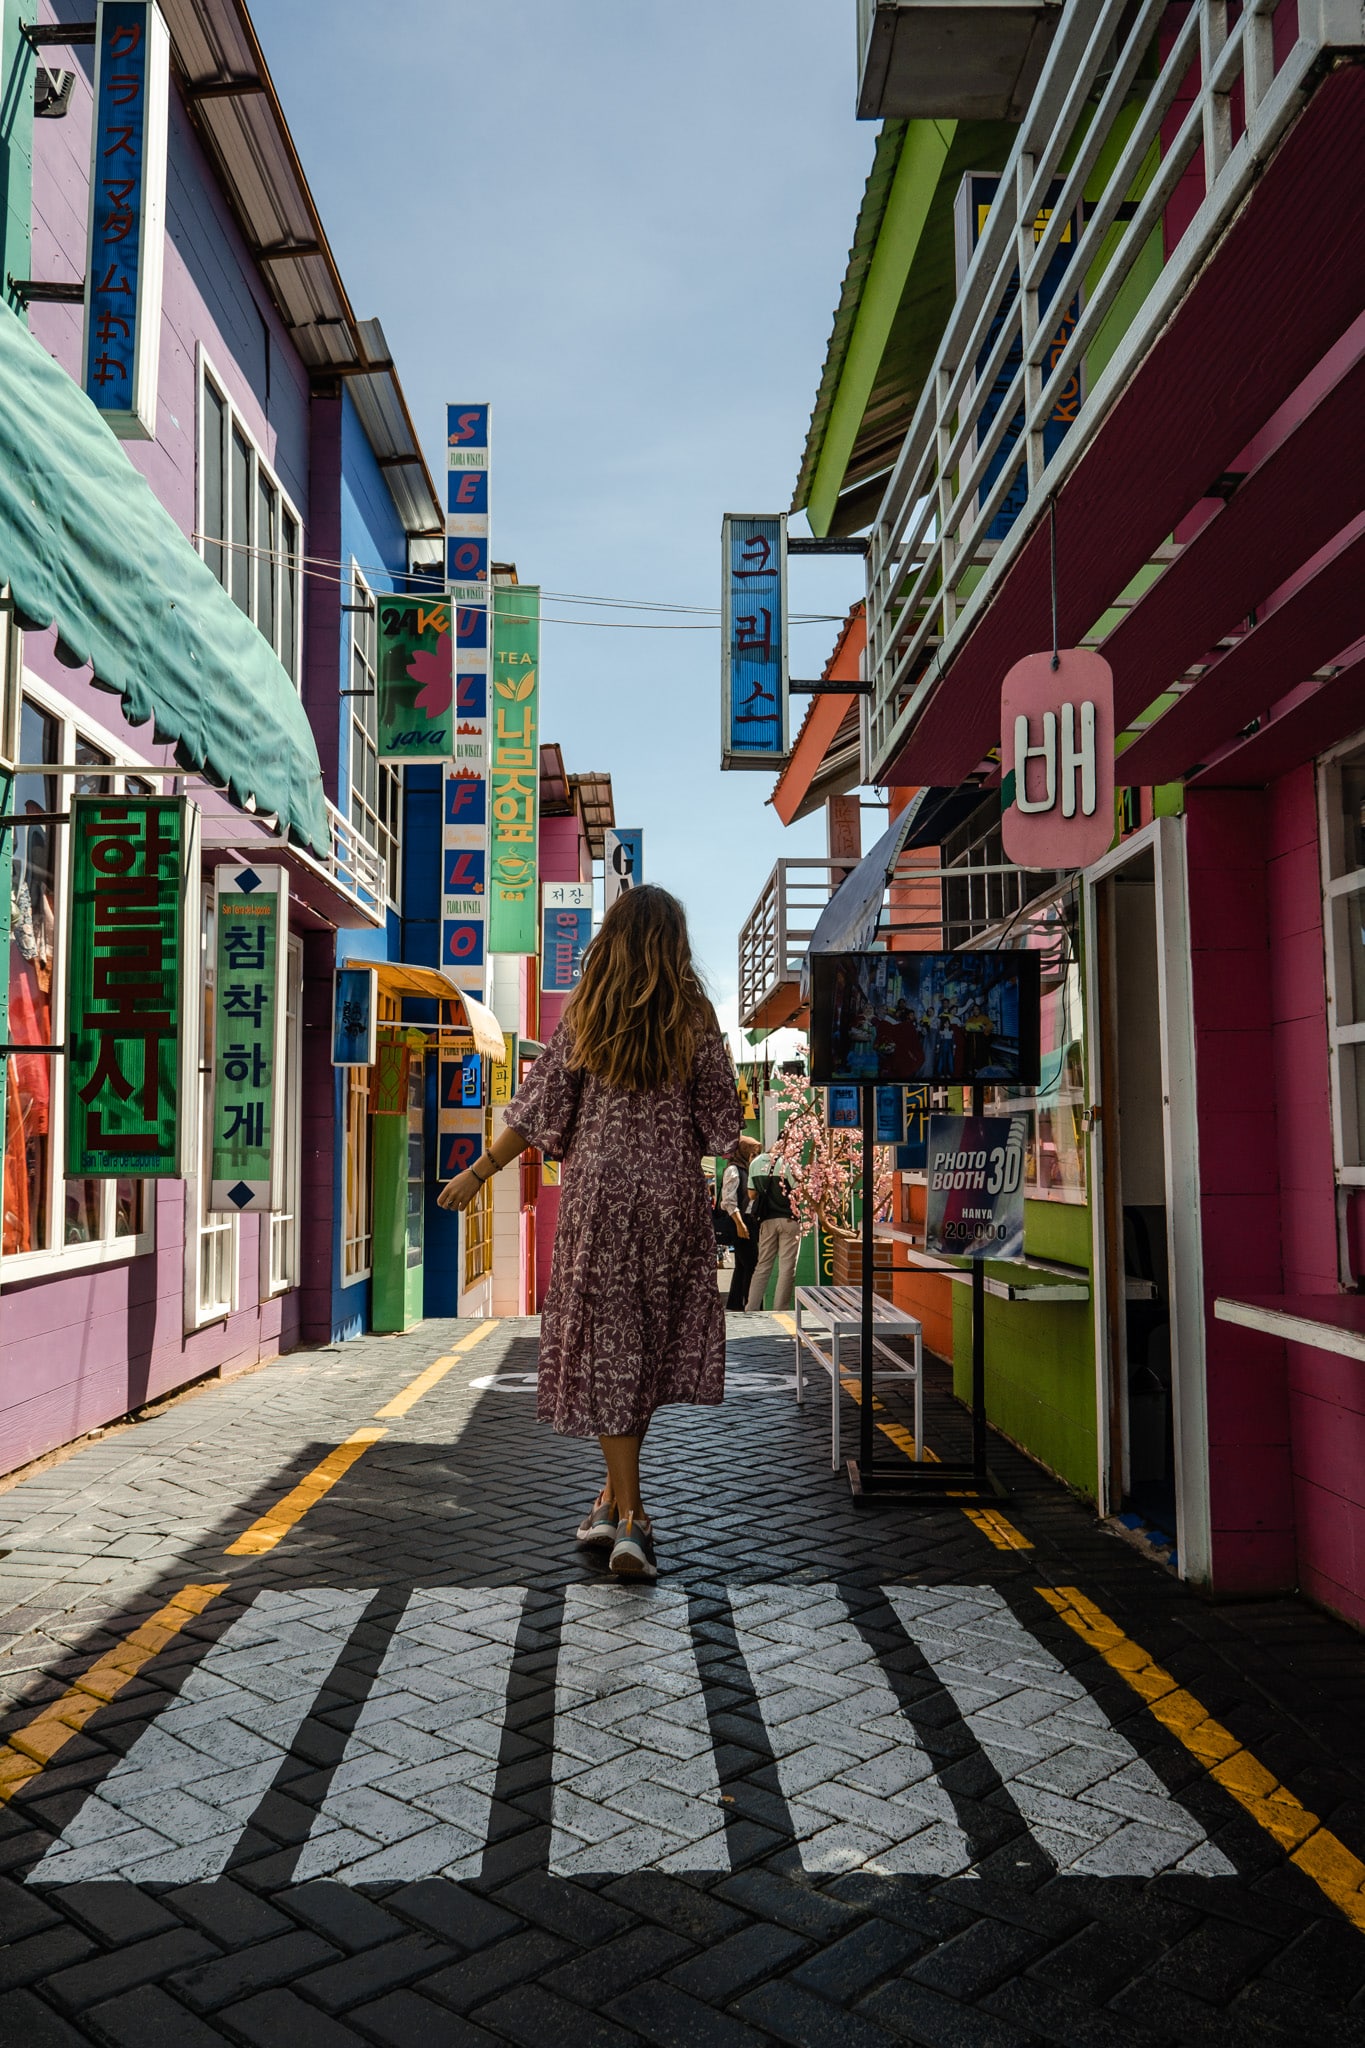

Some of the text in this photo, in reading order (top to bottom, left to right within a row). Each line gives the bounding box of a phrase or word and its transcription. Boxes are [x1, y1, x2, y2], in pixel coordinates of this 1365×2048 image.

[450, 452, 484, 467] FLORA WISATA
[732, 534, 779, 723] 크리스
[498, 652, 532, 665] TEA
[464, 743, 482, 758] WISATA
[1014, 701, 1097, 818] 배
[499, 890, 525, 902] tea
[551, 887, 584, 905] 저장
[446, 900, 481, 914] FLORA WISATA
[555, 912, 579, 985] 87mm
[78, 807, 172, 1152] 할로신
[222, 926, 269, 1147] 침착하게
[933, 1150, 987, 1171] PHOTO
[986, 1146, 1021, 1195] 3D
[931, 1170, 986, 1191] BOOTH
[961, 1207, 993, 1219] HANYA
[945, 1221, 1007, 1241] 20.000
